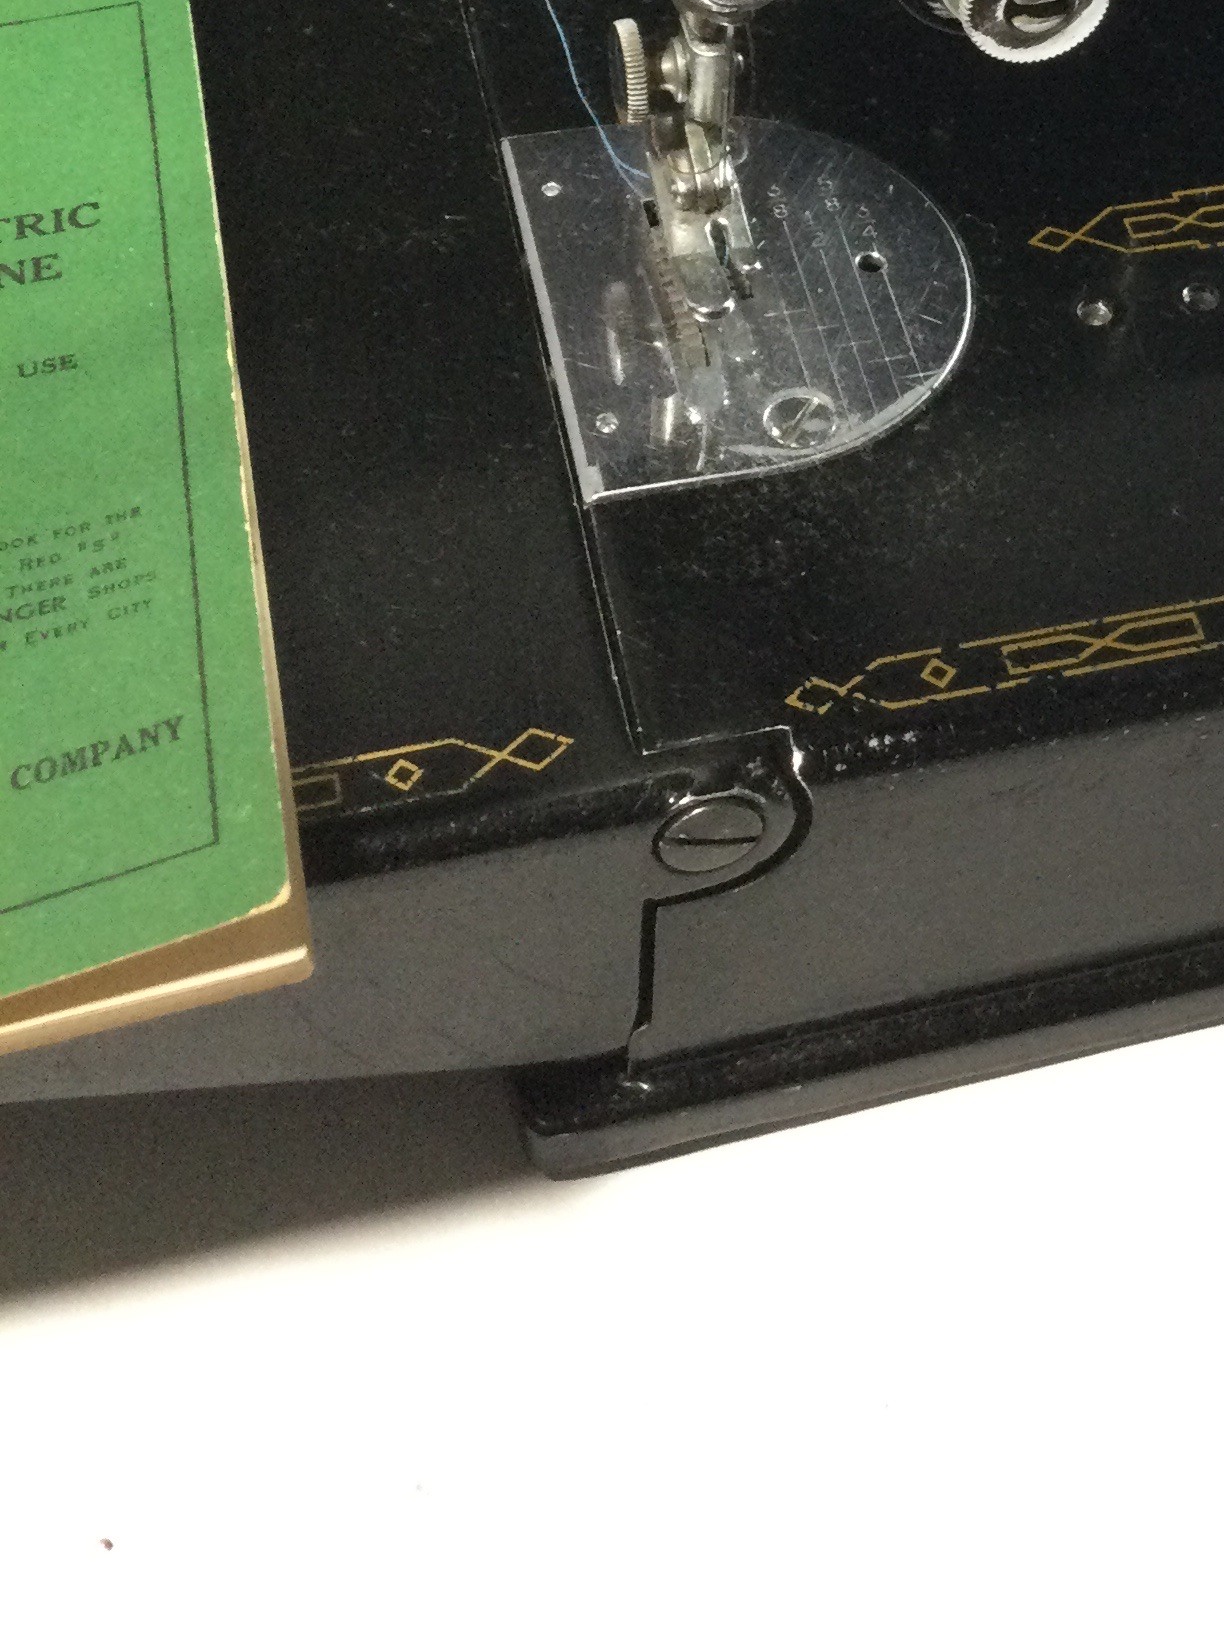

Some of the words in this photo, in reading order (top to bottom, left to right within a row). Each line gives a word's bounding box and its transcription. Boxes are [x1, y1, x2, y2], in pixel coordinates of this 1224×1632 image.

[17, 353, 79, 379] USE
[52, 521, 91, 539] FOR
[4, 573, 74, 599] THERE
[87, 570, 157, 600] SHOPS
[107, 599, 153, 621] CITY
[10, 714, 184, 791] COMPANY
